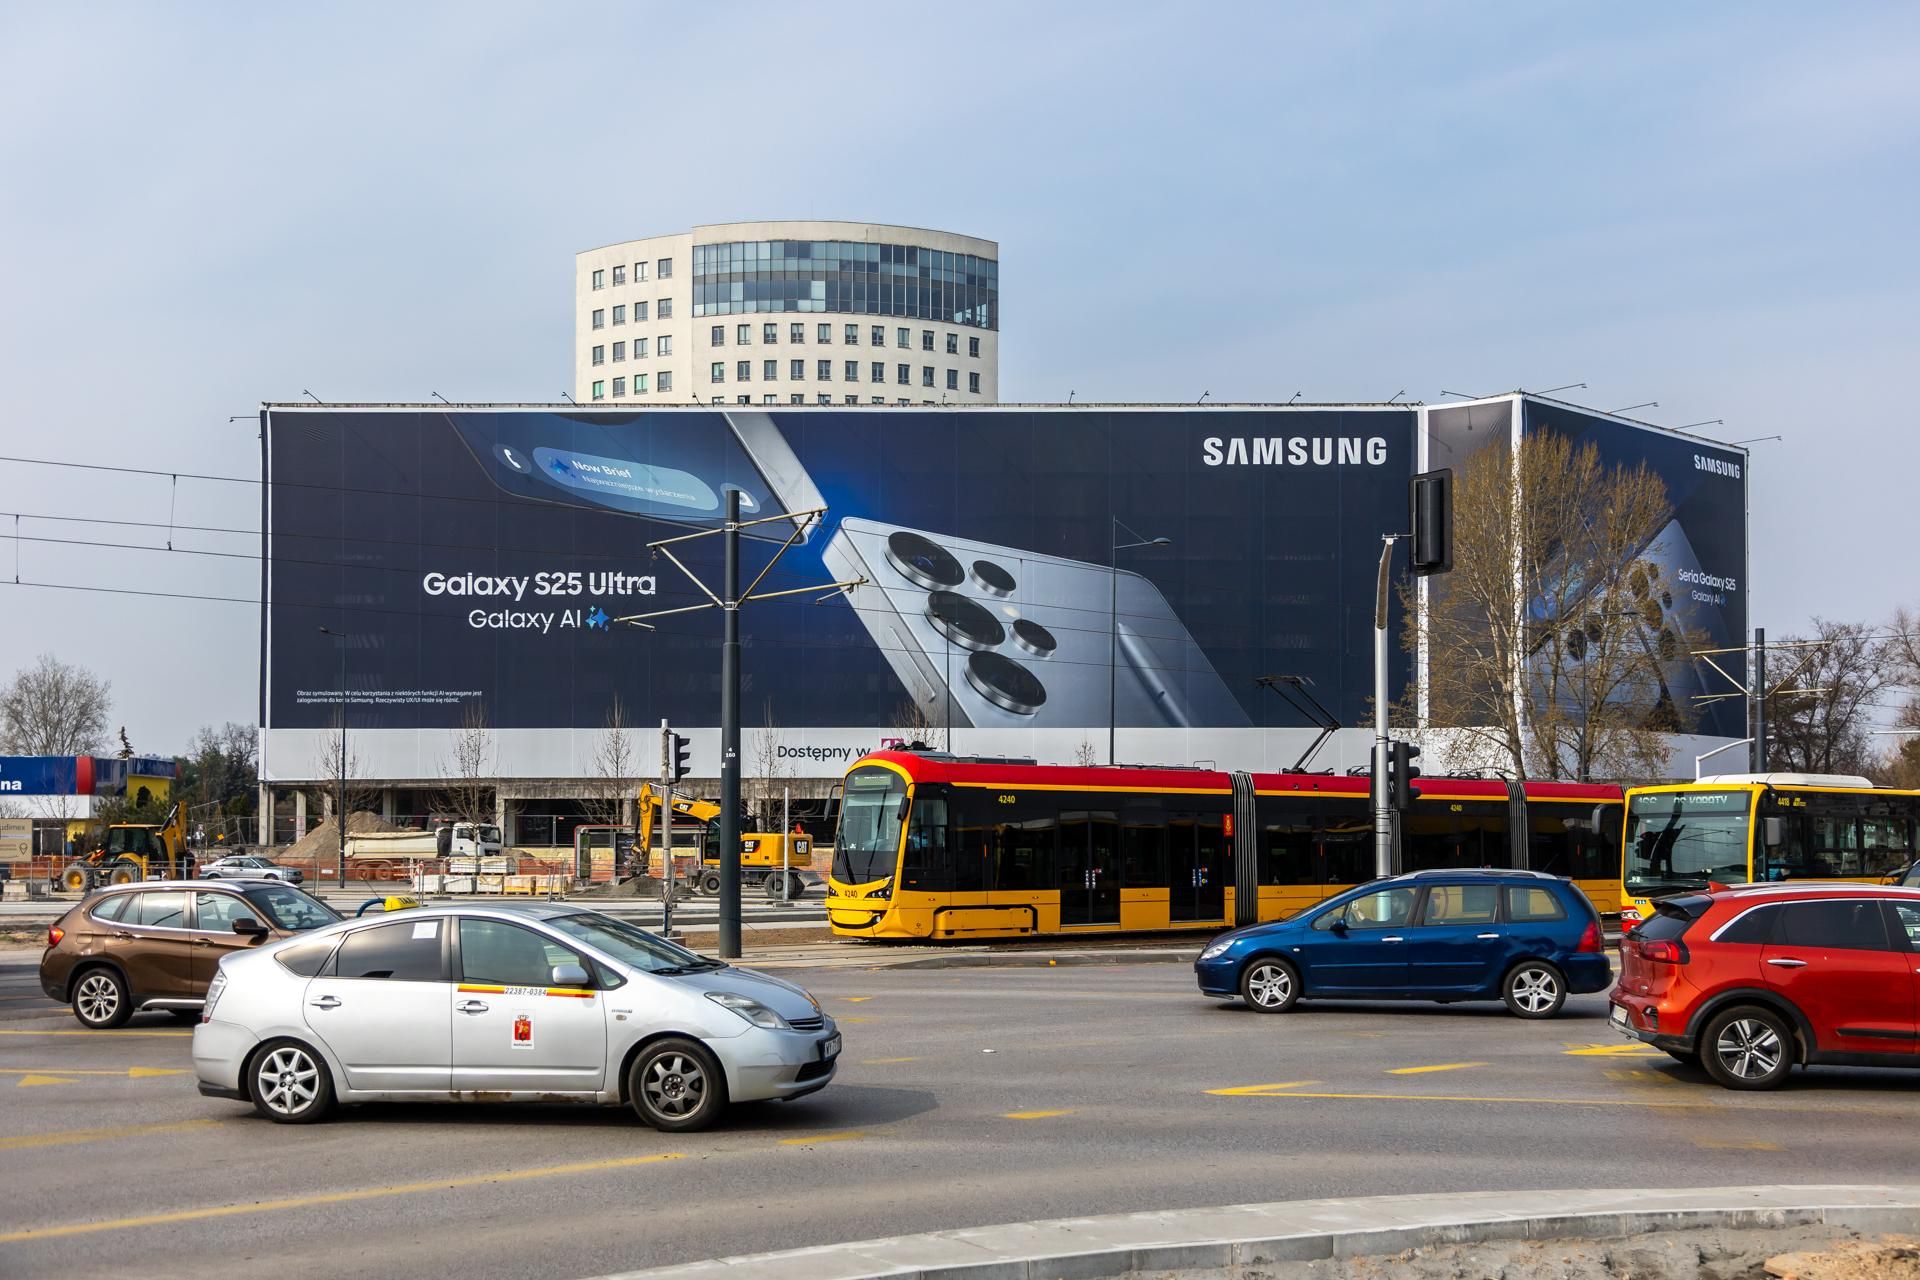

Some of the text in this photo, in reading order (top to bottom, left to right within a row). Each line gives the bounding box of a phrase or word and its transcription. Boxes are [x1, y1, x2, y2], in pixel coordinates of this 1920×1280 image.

[1203, 436, 1387, 466] SAMSUNG
[572, 460, 632, 479] Now Brief
[1693, 454, 1741, 479] SAMSUNG
[423, 571, 656, 601] Galaxy S25 Ultra
[1678, 568, 1737, 592] Seria Galaxy S25
[1691, 589, 1721, 607] Galaxy AI
[468, 609, 581, 634] Galaxy AI
[777, 745, 871, 762] Dostępny w
[679, 803, 689, 812] CAT
[998, 794, 1016, 804] 4240
[744, 840, 754, 848] CAT
[796, 840, 808, 853] CAT
[844, 889, 858, 899] 4240
